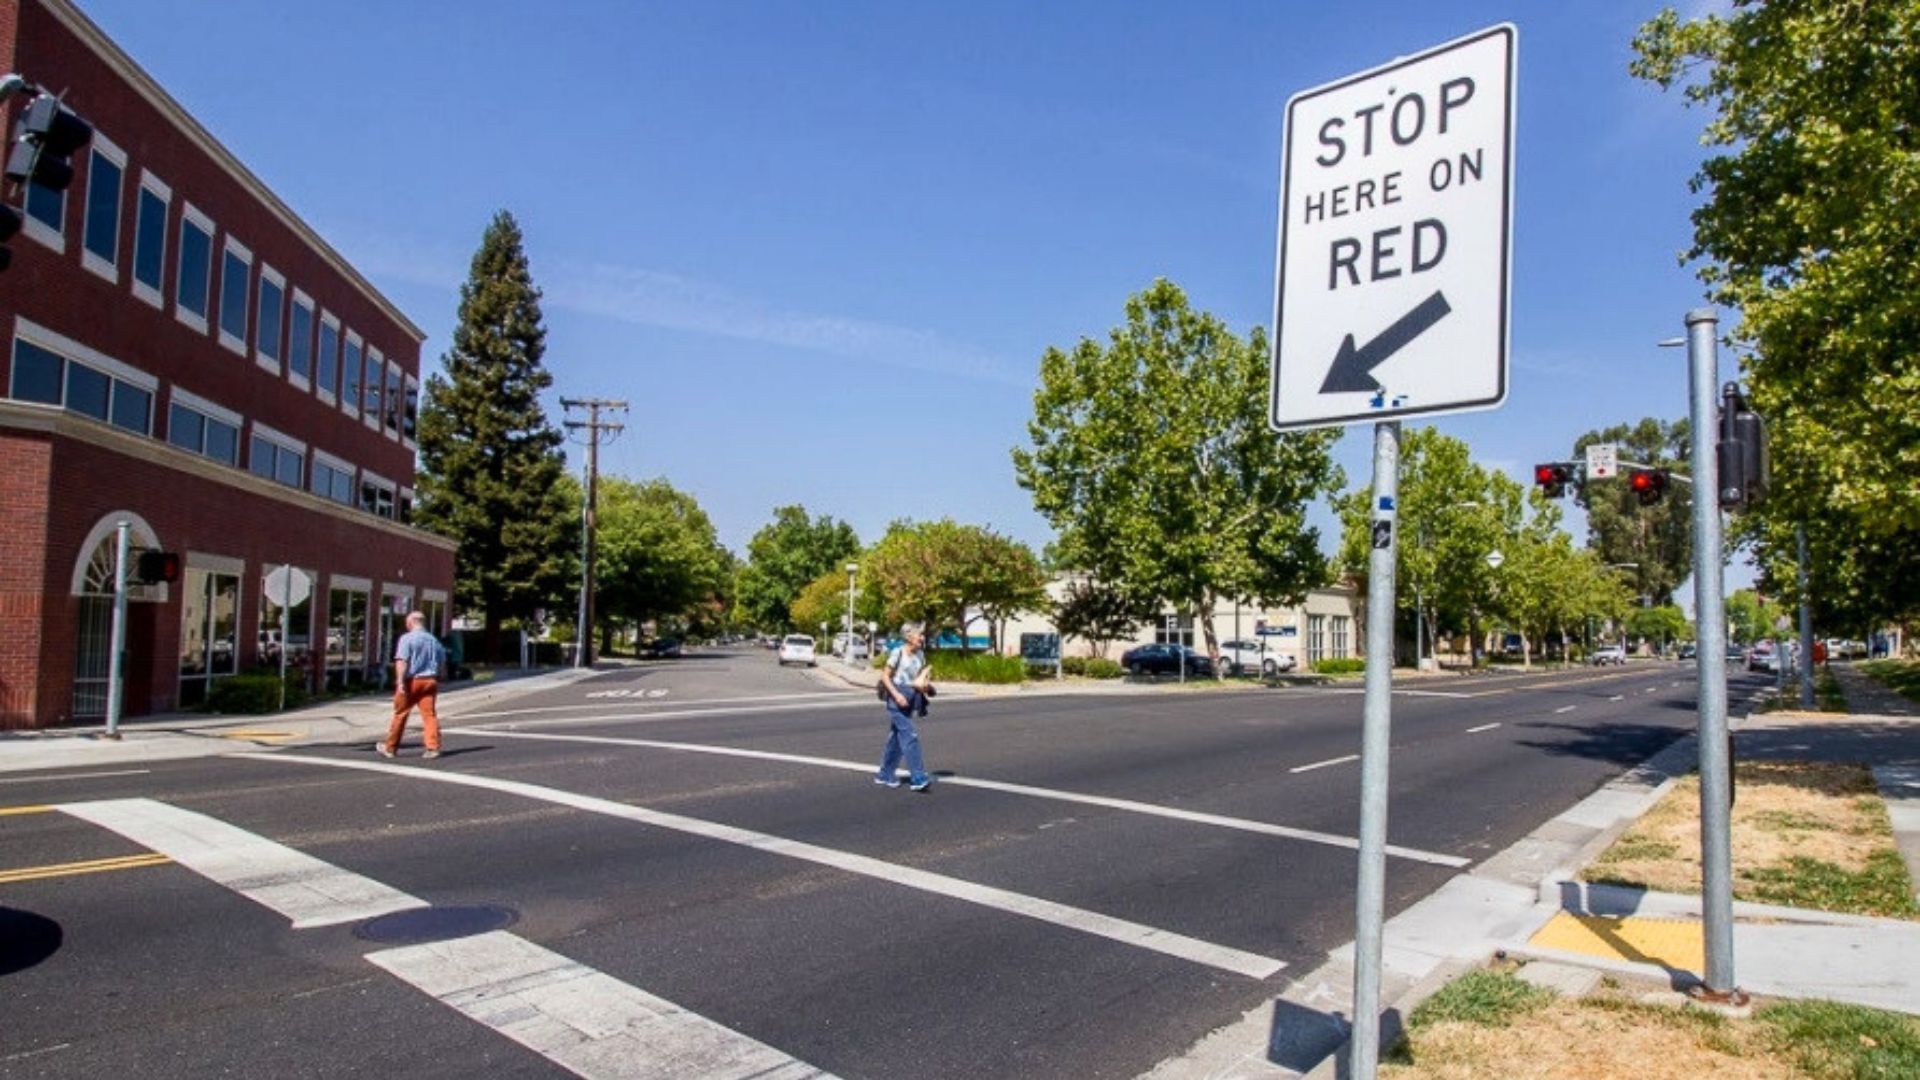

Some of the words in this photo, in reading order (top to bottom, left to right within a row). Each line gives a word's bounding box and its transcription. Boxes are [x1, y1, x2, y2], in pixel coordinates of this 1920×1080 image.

[1316, 77, 1475, 167] STOP
[1304, 171, 1402, 224] HERE
[1430, 148, 1484, 192] ON
[1328, 218, 1448, 291] RED
